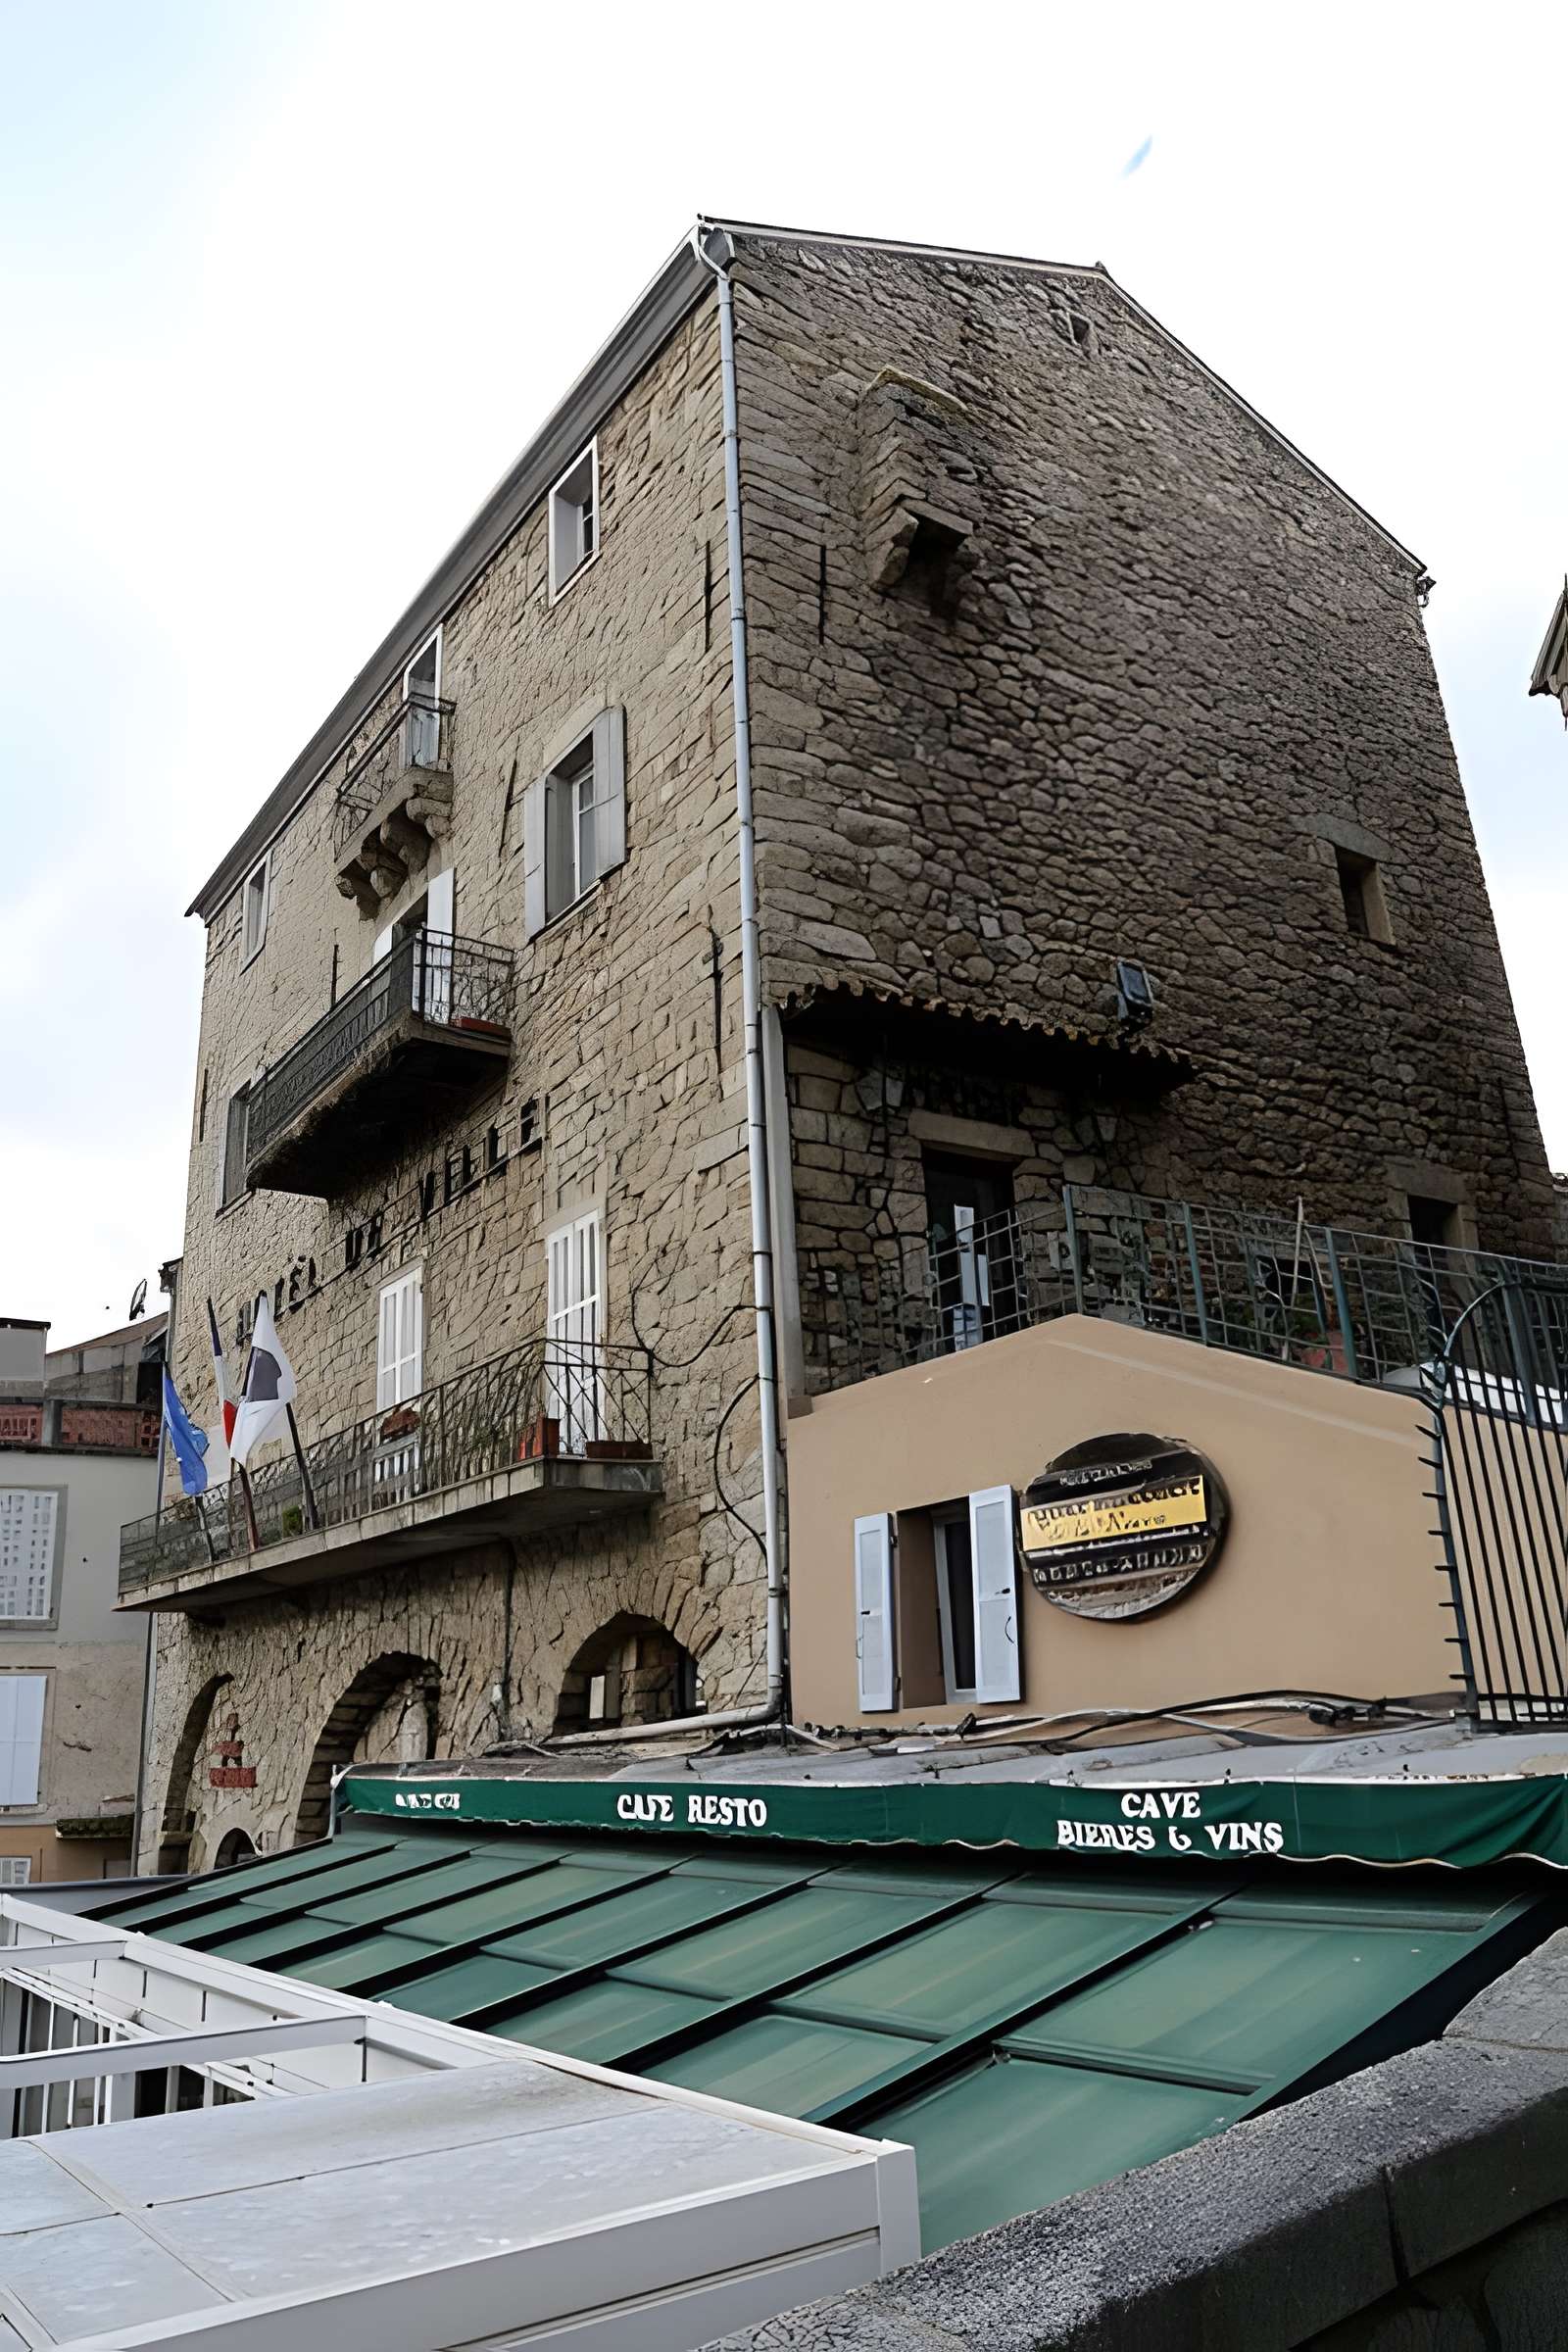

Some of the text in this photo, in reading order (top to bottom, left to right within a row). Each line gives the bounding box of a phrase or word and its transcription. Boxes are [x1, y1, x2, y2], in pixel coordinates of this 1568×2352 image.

[687, 1794, 767, 1828] RESTO
[1120, 1791, 1201, 1819] CAVE
[1203, 1821, 1284, 1853] VINS
